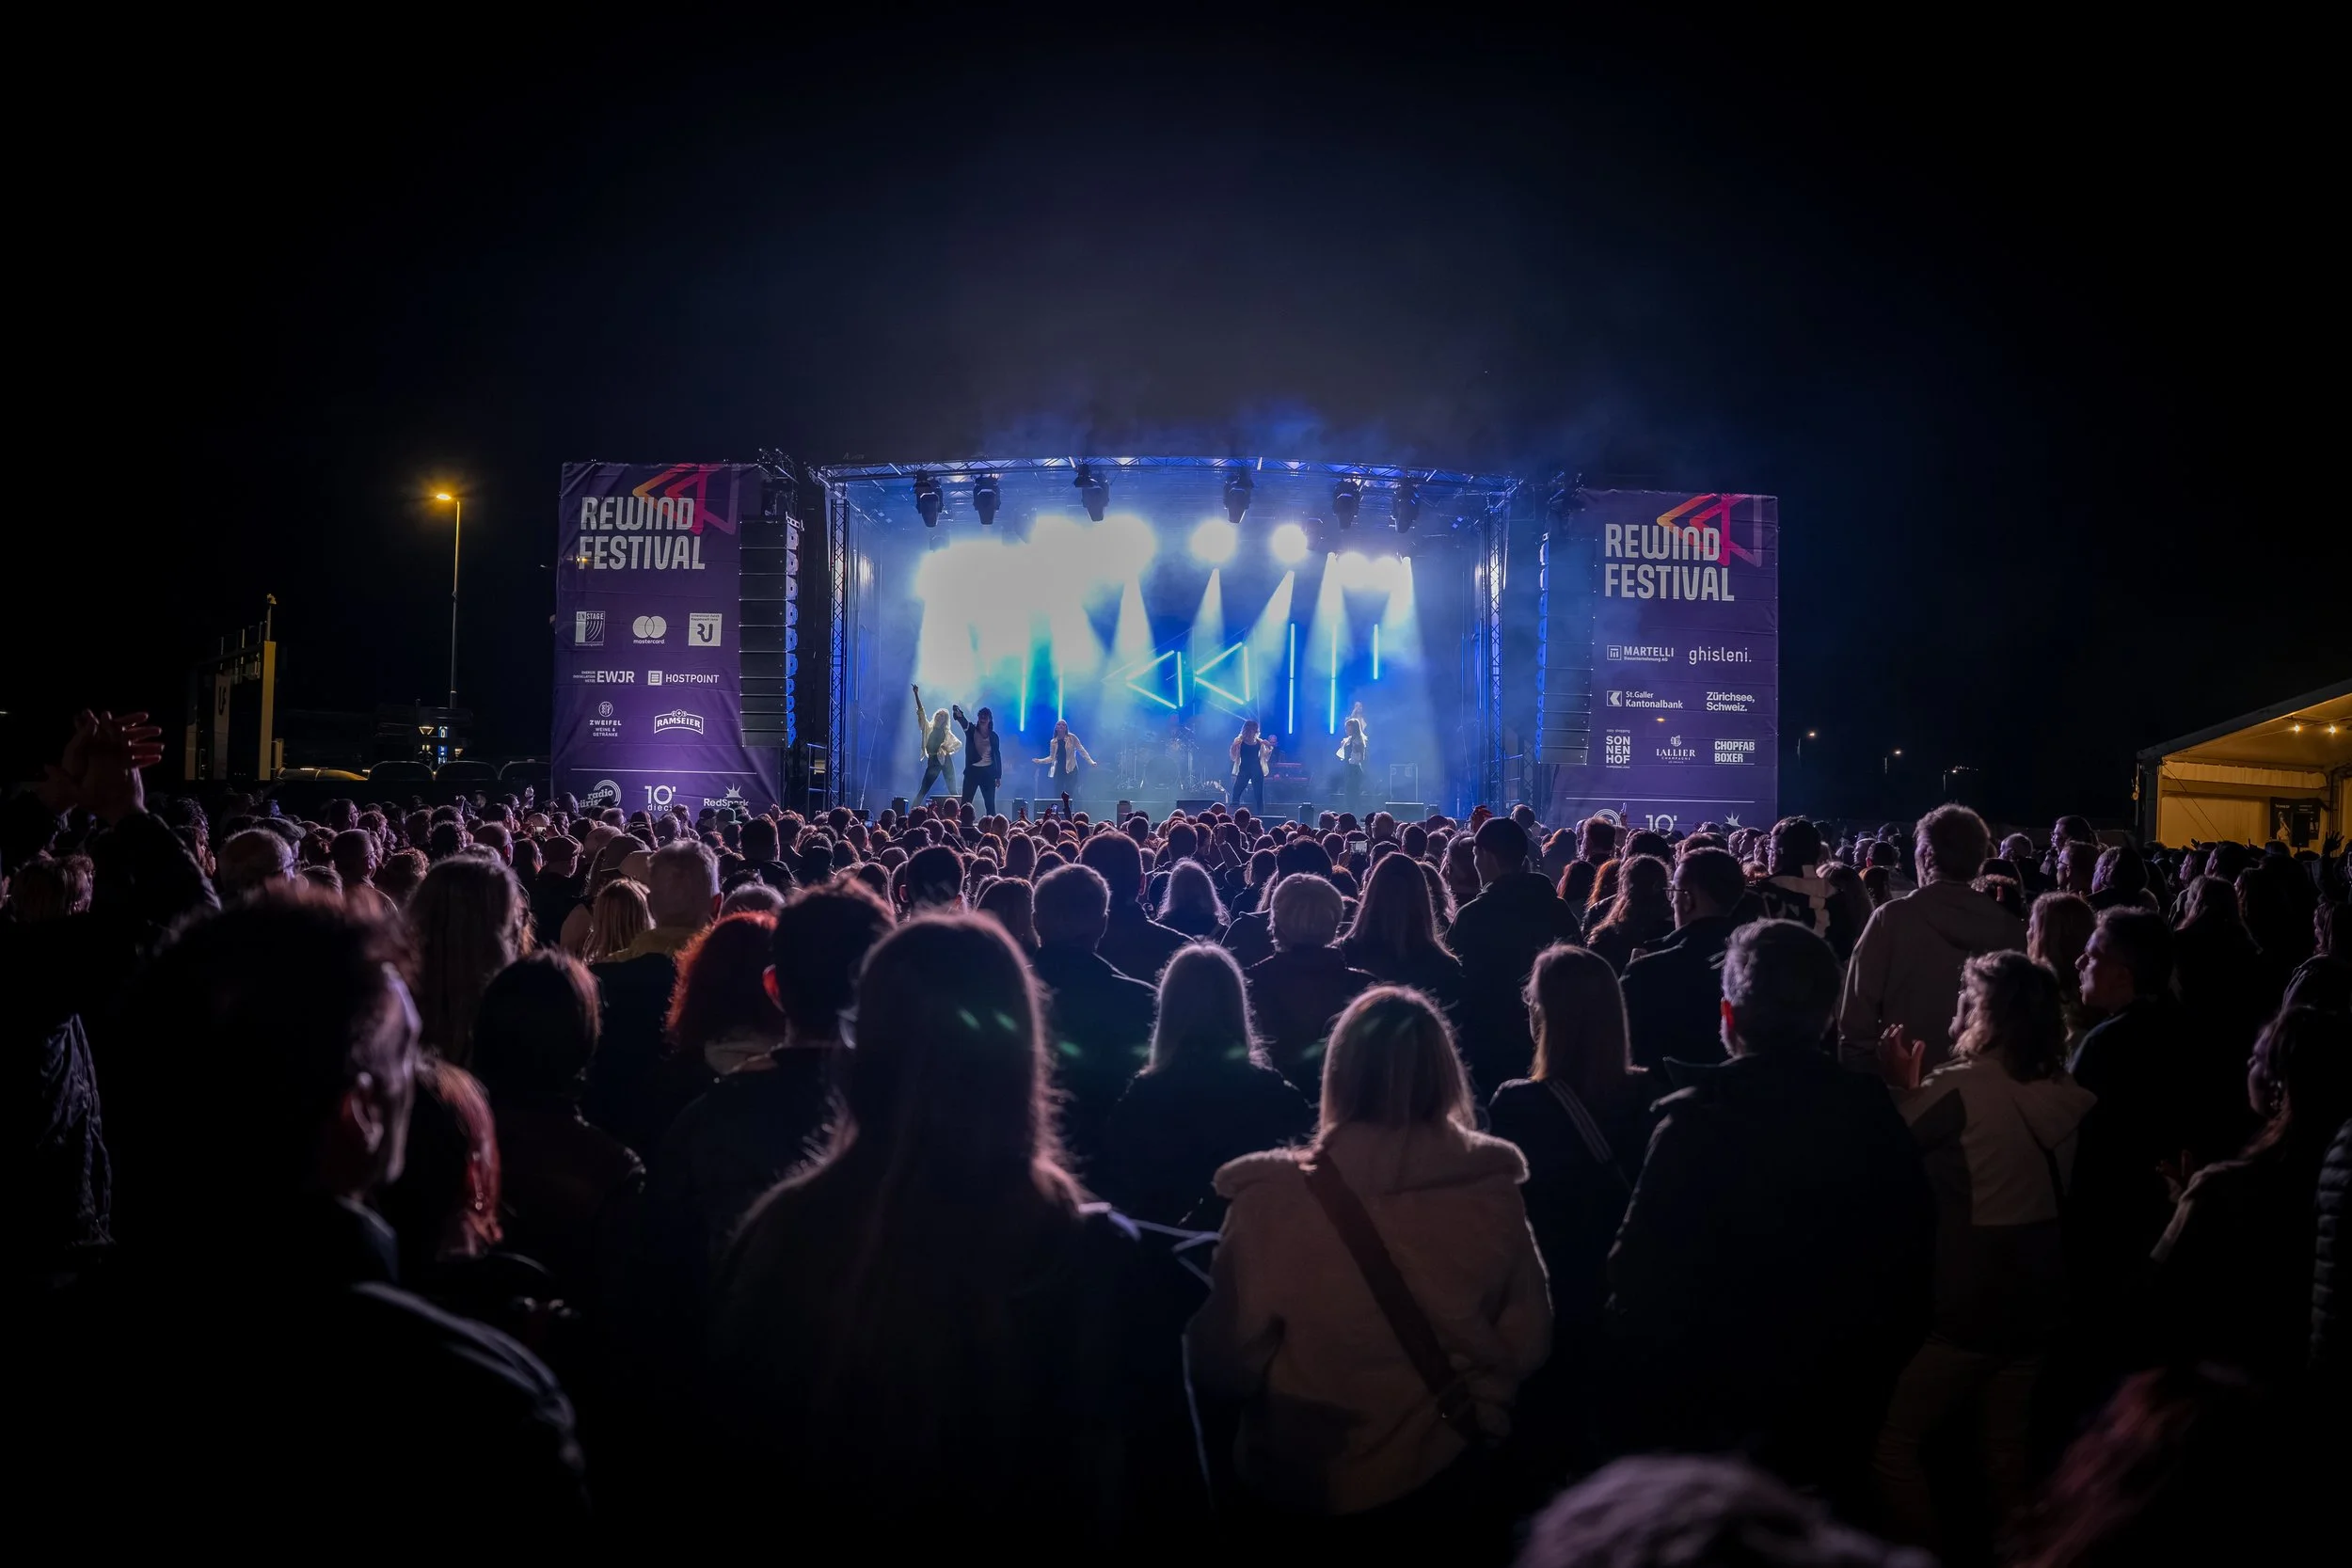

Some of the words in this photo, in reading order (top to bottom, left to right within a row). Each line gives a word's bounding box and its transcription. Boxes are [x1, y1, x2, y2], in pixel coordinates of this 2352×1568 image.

[580, 497, 694, 531] REWIND
[1605, 523, 1720, 562] REWIND
[579, 535, 706, 570] FESTIVAL
[1605, 562, 1735, 601] FESTIVAL
[1624, 645, 1675, 657] MARTELLI
[1689, 646, 1752, 665] ghisleni.
[596, 671, 635, 683] EWJR
[665, 673, 720, 684] HOSTPOINT
[1707, 691, 1756, 703] Zürichsee,
[1626, 700, 1683, 709] Kantonalbank
[1707, 702, 1748, 712] Schweiz.
[657, 717, 701, 728] RAMSEIER
[1606, 736, 1630, 745] SON
[1714, 740, 1755, 752] CHOPFAB
[1606, 745, 1630, 754] NEN
[1606, 754, 1630, 764] HOF
[1714, 752, 1743, 763] BOXER
[587, 788, 613, 800] radio
